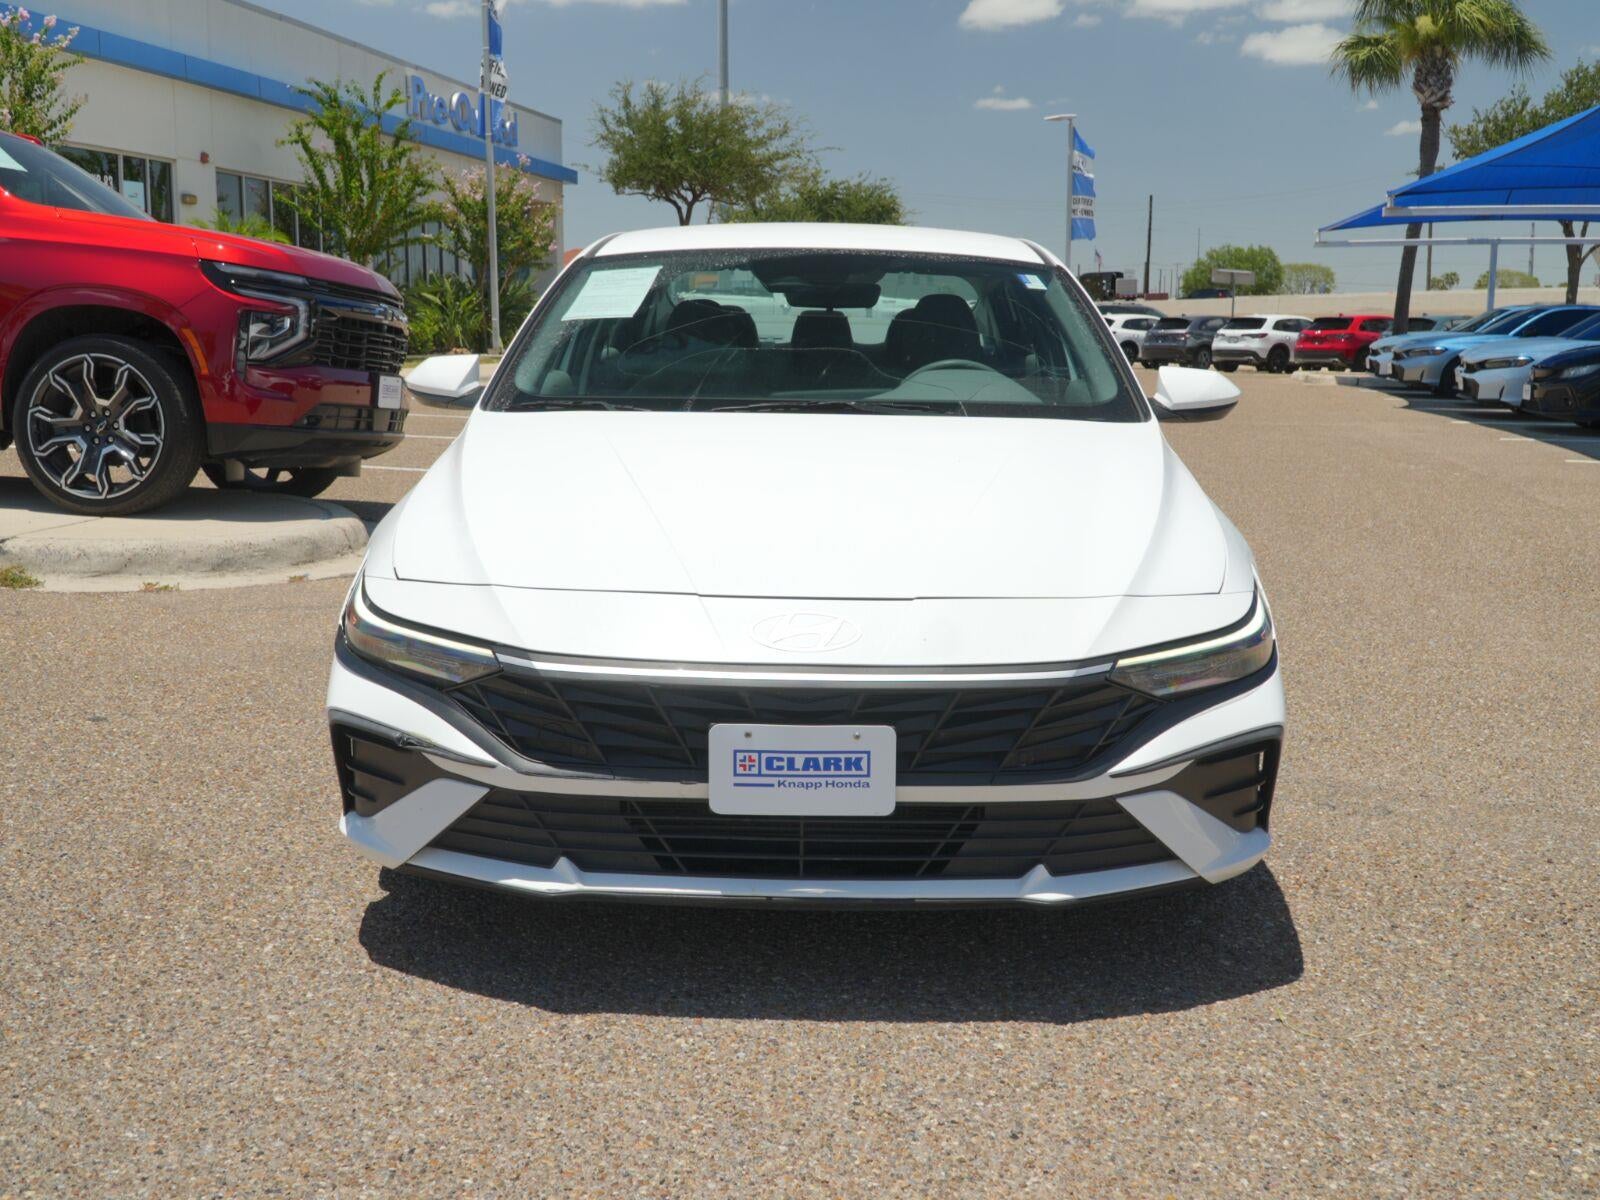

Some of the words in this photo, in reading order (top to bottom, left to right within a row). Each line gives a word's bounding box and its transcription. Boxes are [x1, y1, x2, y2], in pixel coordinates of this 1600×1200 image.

[765, 756, 864, 772] CLARK
[777, 780, 822, 790] Knapp
[825, 780, 870, 788] Honda
